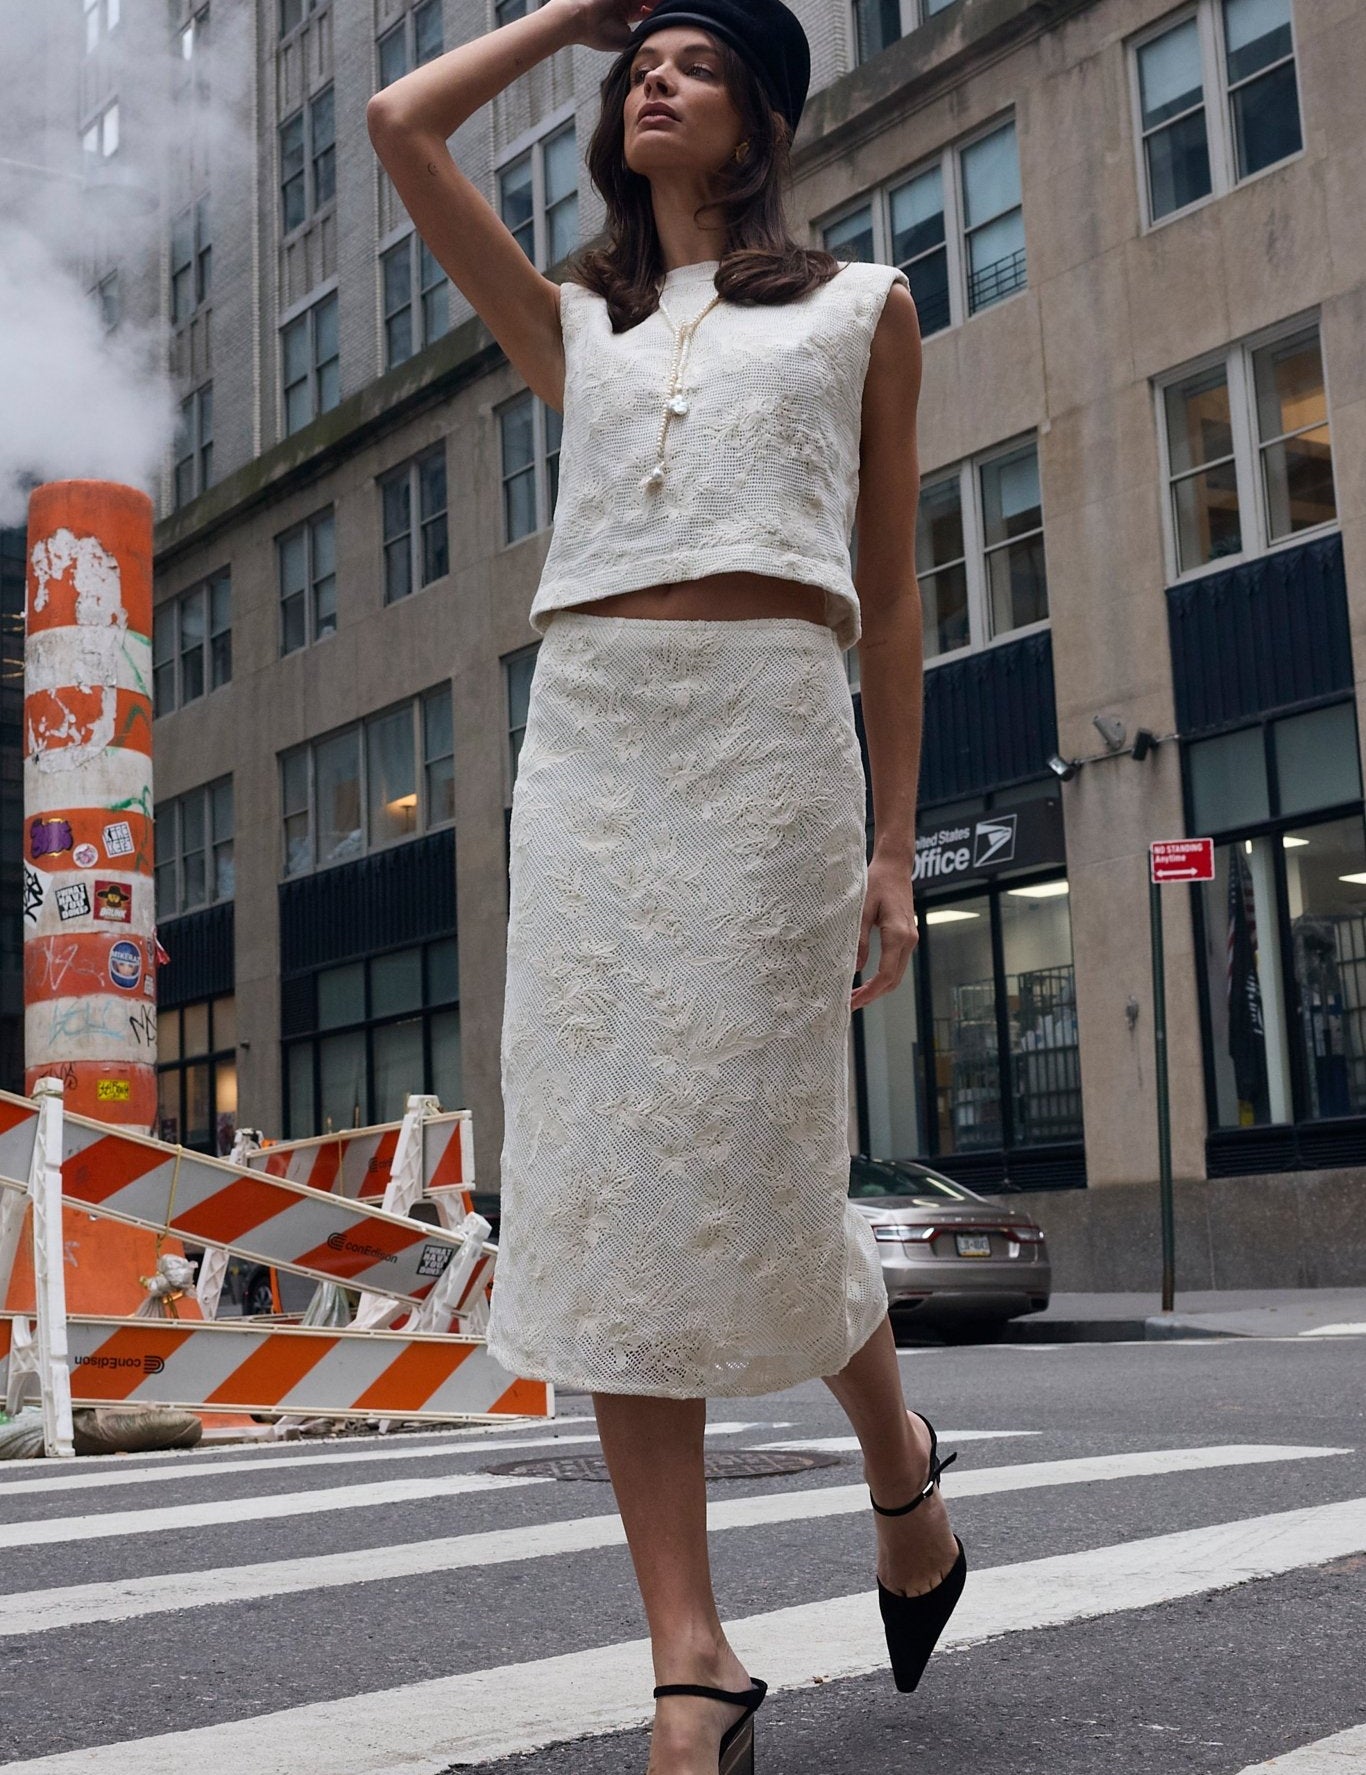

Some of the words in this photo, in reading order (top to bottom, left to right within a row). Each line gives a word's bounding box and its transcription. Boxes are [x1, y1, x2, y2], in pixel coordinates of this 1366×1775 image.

[915, 832, 938, 850] nited
[938, 828, 970, 845] States
[1154, 846, 1166, 854] NO
[1166, 843, 1203, 854] STANDING
[1155, 855, 1187, 864] Anytime
[345, 1242, 398, 1263] conEdison
[74, 1356, 142, 1369] conEdison
